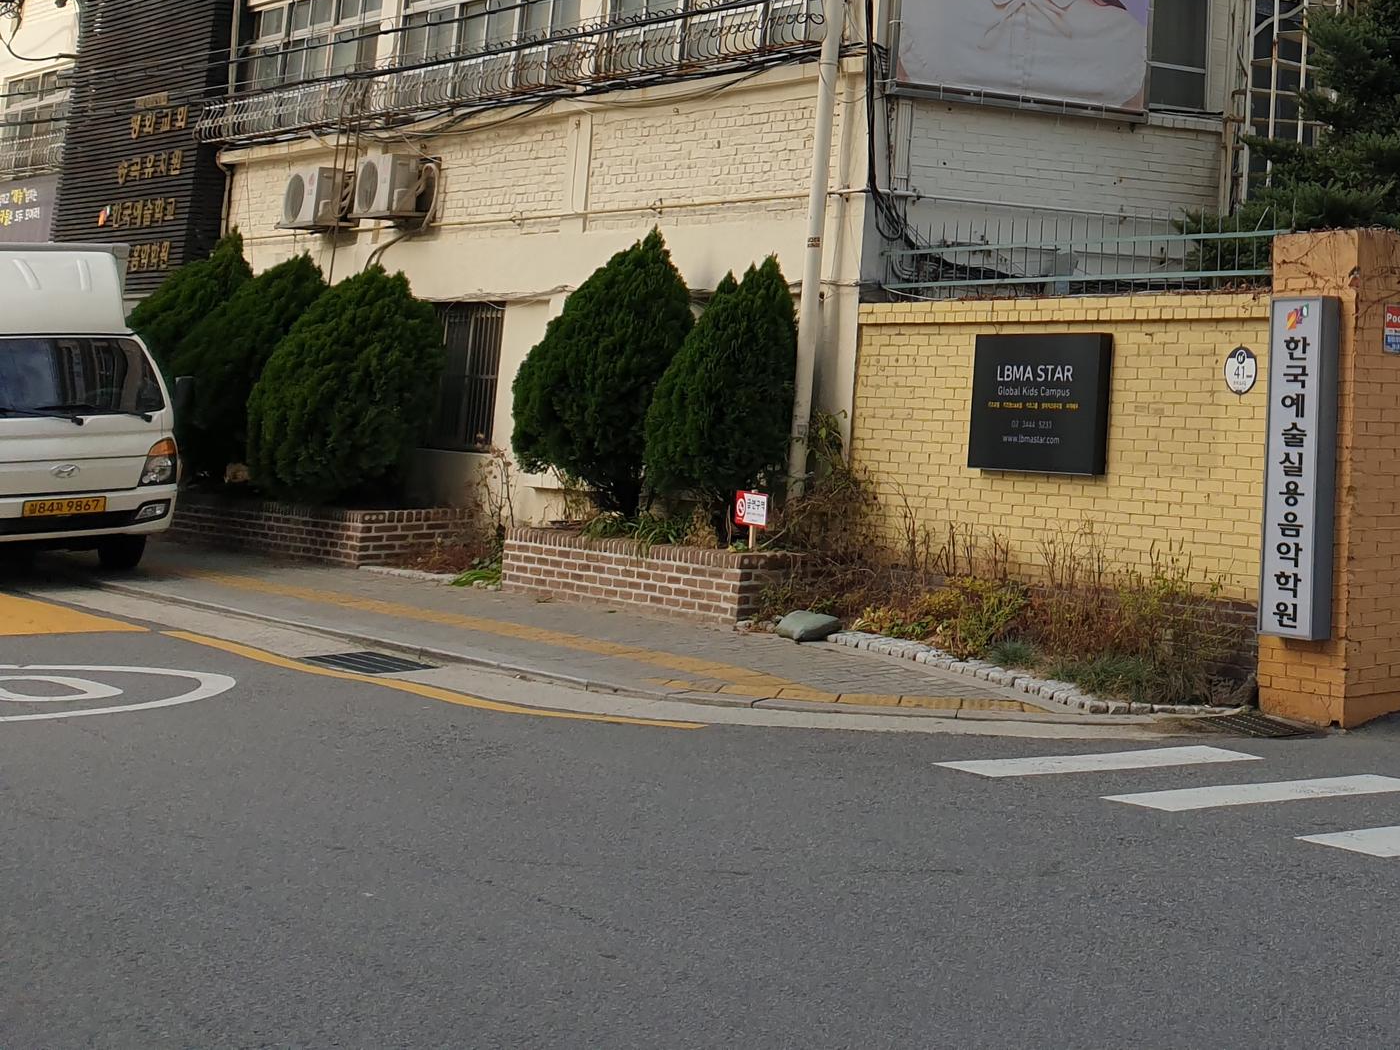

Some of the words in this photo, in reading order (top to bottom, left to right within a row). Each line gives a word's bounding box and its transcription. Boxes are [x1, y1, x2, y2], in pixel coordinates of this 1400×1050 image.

[128, 239, 172, 272] 음악학원
[997, 365, 1034, 382] LBMA
[1036, 365, 1073, 382] STAR
[1233, 365, 1245, 380] 41
[997, 385, 1021, 396] Global
[1022, 385, 1039, 397] Kids
[1040, 386, 1071, 399] Campus
[1002, 434, 1060, 445] www.lbmastar.com
[1272, 336, 1311, 630] 한국예술실용음악학원
[66, 499, 101, 512] 9867
